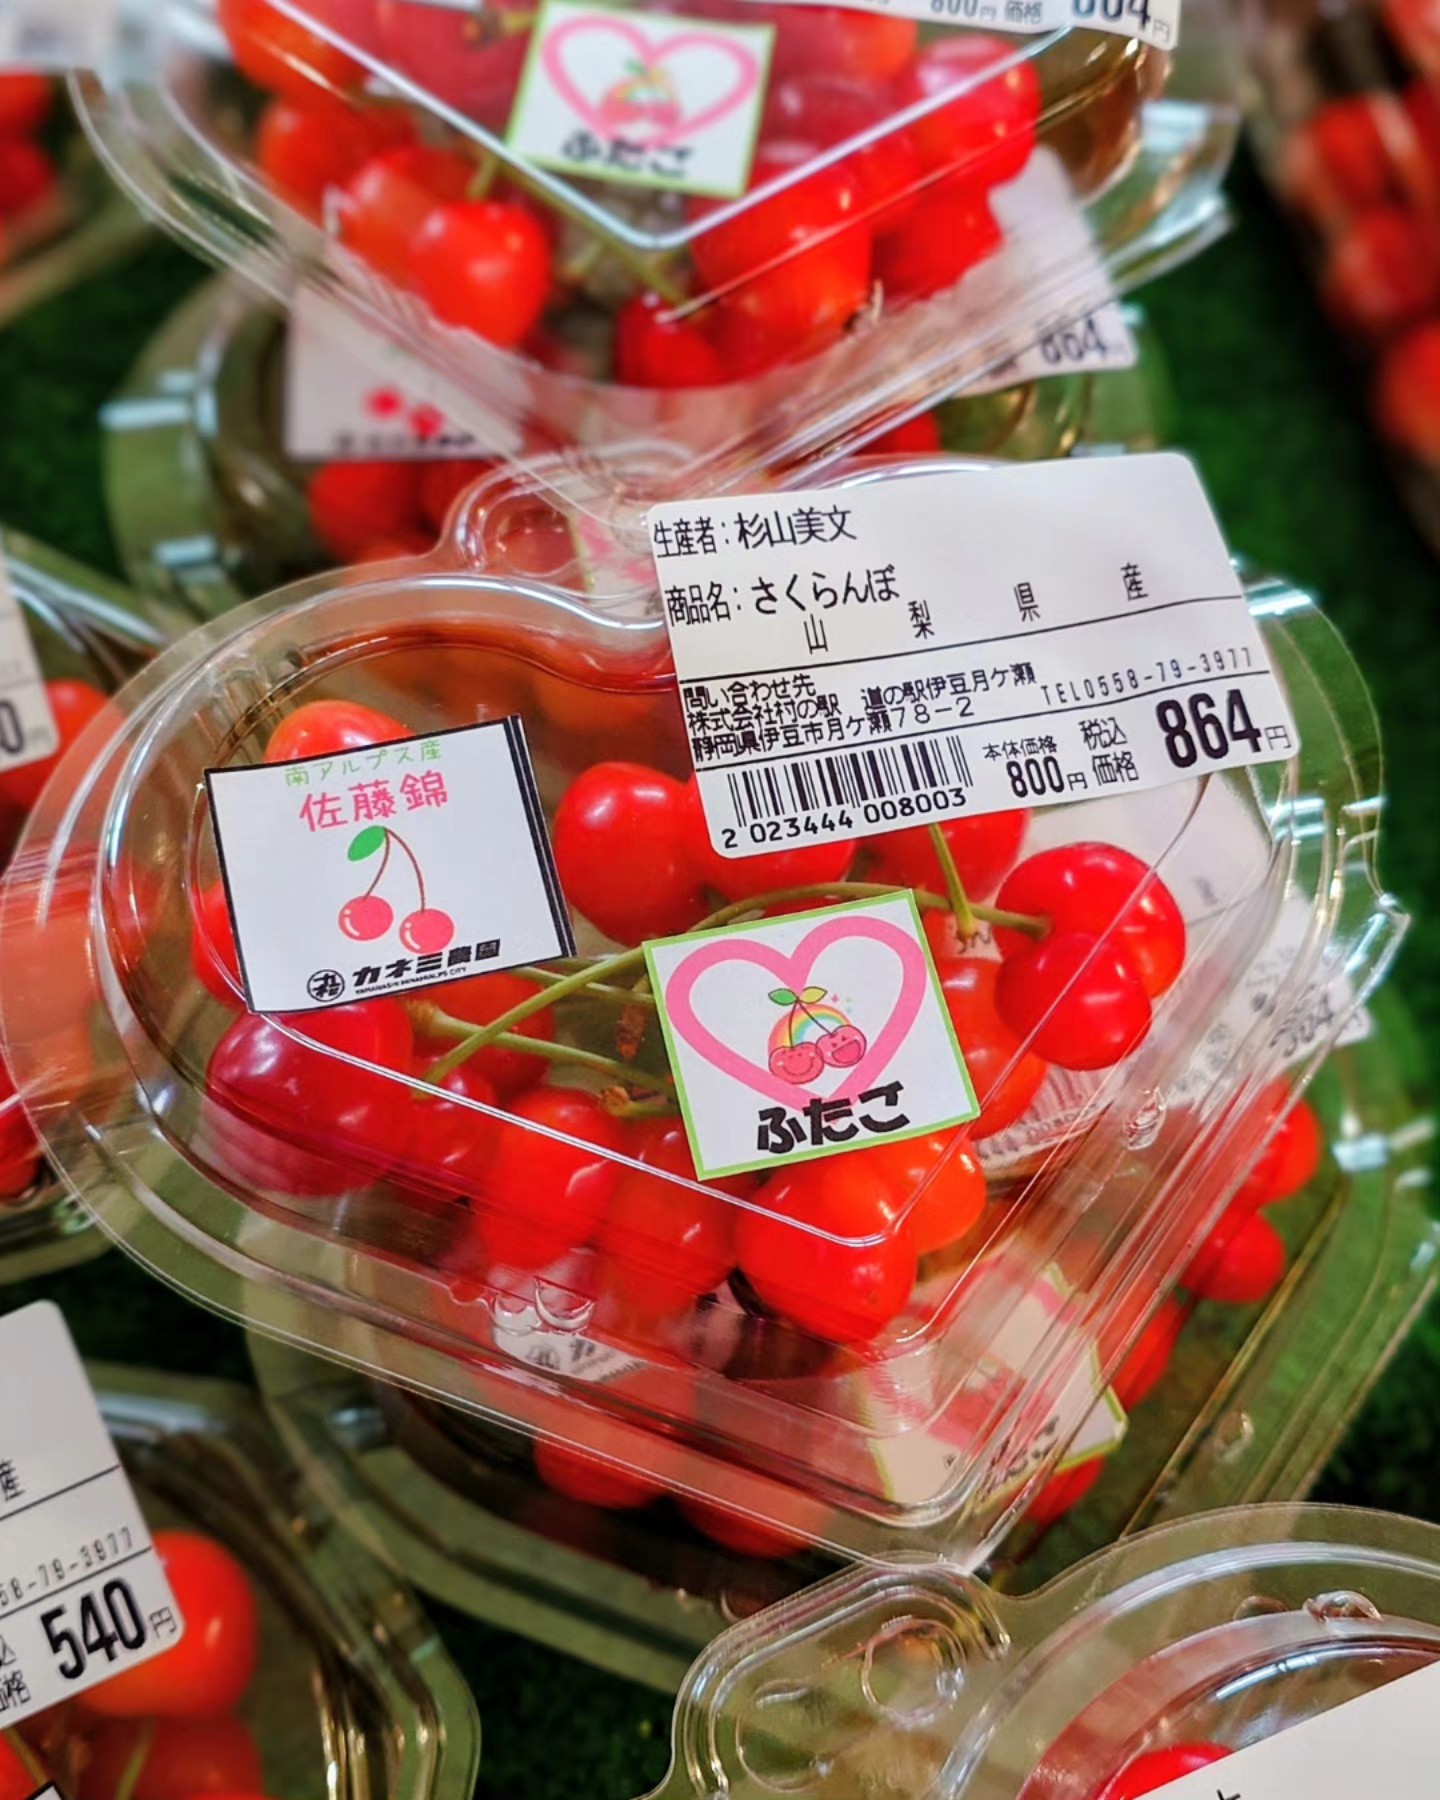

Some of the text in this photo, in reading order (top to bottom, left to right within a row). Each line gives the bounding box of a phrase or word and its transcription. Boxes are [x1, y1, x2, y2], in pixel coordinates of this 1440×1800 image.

[682, 673, 817, 711] 問い合わせ先
[1041, 647, 1253, 706] TEL0558-79-3977
[300, 769, 448, 832] 佐藤錦
[721, 786, 967, 850] 2 023444 008003
